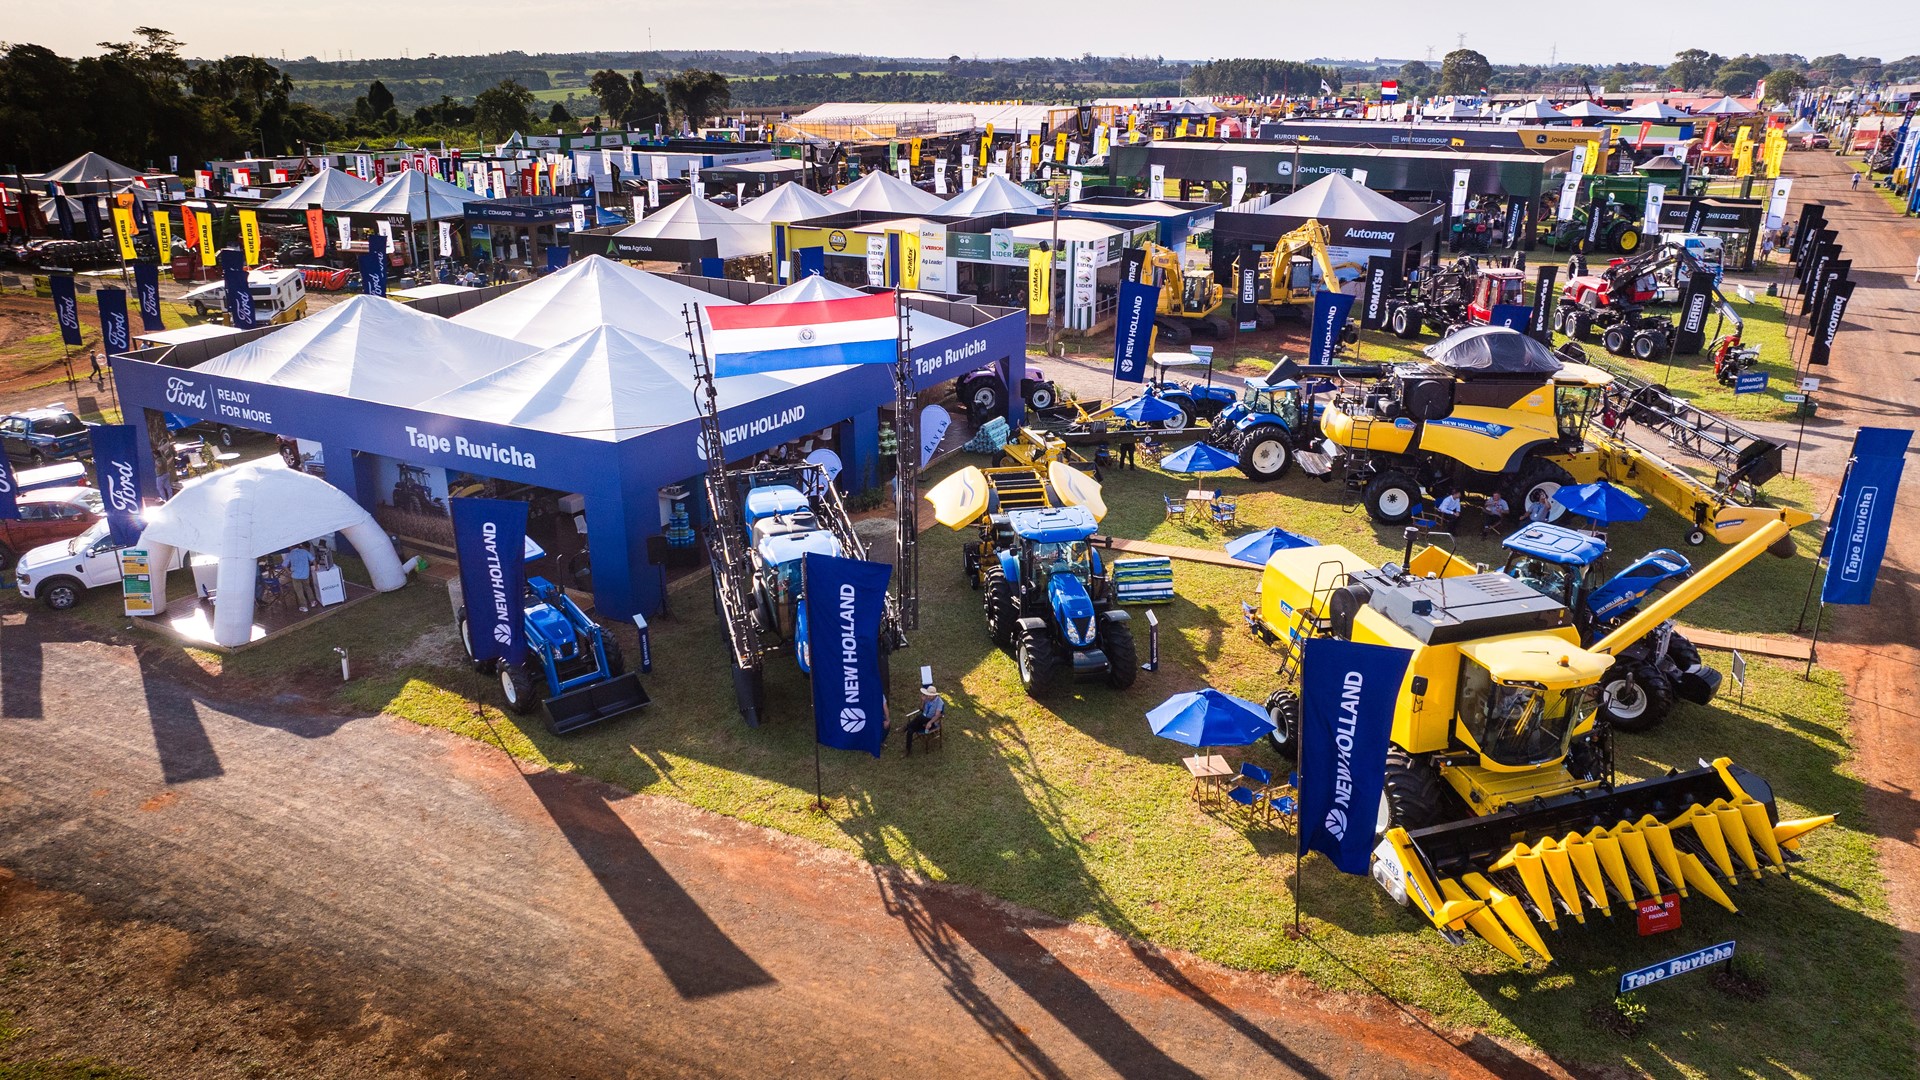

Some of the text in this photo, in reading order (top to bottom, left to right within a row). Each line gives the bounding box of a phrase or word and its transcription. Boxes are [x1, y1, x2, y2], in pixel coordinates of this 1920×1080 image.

[1670, 210, 1688, 218] COLEC
[160, 223, 169, 252] FUELPAR
[246, 223, 255, 254] FUELPAR
[1345, 228, 1395, 242] Automaq
[992, 250, 1012, 258] LIDER
[142, 284, 158, 316] Ford
[1244, 272, 1253, 300] CLARK
[1368, 269, 1384, 319] KOMATSU
[60, 296, 78, 330] Ford
[236, 291, 252, 324] Ford
[1128, 296, 1142, 337] HOLLAND
[1536, 279, 1550, 332] KOMATSU
[1687, 295, 1704, 330] CLARK
[1824, 296, 1846, 348] Automaq
[108, 312, 127, 349] Ford
[1324, 306, 1337, 348] HOLLAND
[916, 339, 986, 376] Tape Ruvicha
[1126, 338, 1134, 358] NEW
[166, 376, 207, 410] Ford
[218, 388, 250, 404] READY
[220, 404, 272, 424] FOR MORE
[720, 405, 805, 447] NEW HOLLAND
[1458, 422, 1486, 432] HOLLAND
[405, 426, 536, 469] Tape Ruvicha
[924, 420, 948, 454] RAVEN
[108, 461, 140, 514] Ford
[1845, 492, 1873, 575] Tape Ruvicha
[483, 522, 509, 621] NEW HOLLAND
[1596, 596, 1624, 614] NEW HOLLAND
[840, 584, 860, 703] NEW HOLLAND
[1335, 672, 1363, 808] NEW HOLLAND
[1642, 900, 1674, 914] SUDARIS
[1648, 911, 1668, 920] FINANCIA
[1627, 946, 1732, 988] Tape Ruvicha
